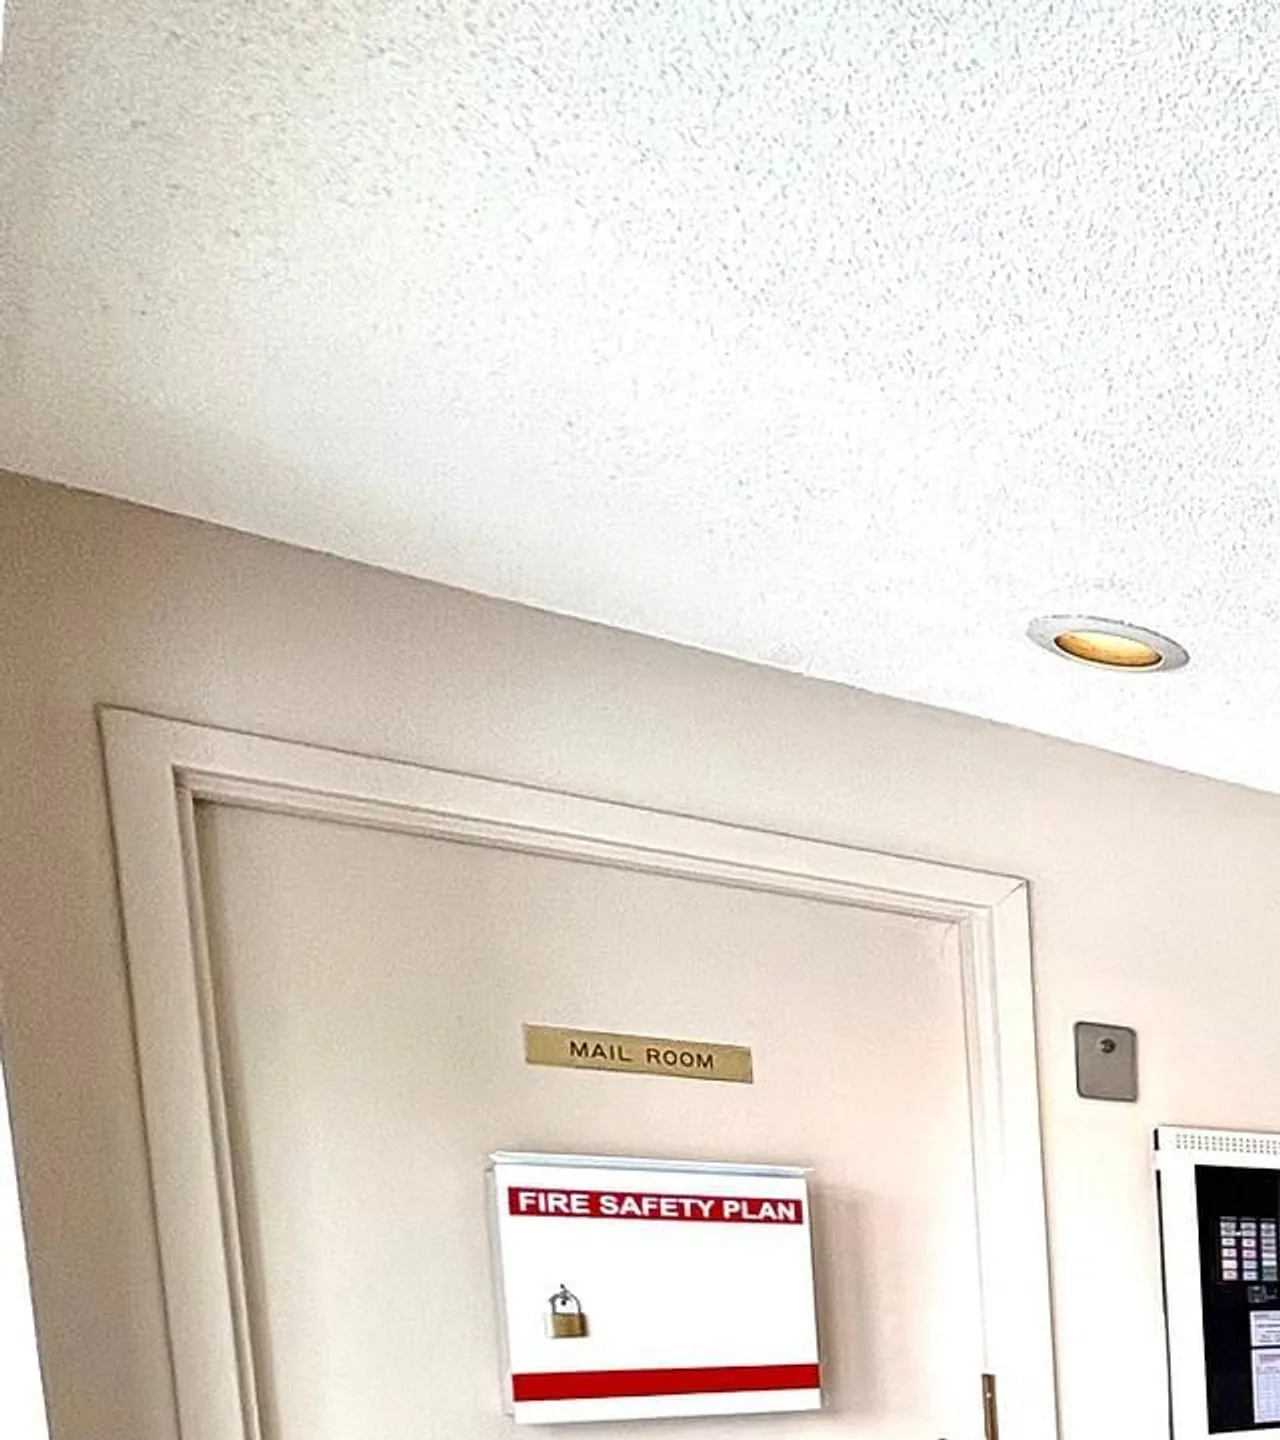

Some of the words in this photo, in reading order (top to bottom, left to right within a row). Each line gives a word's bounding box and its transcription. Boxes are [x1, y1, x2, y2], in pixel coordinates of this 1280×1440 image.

[569, 1039, 631, 1062] MAIL
[646, 1047, 715, 1070] ROOM
[518, 1191, 590, 1214] FIRE
[599, 1195, 716, 1218] SAFETY
[723, 1199, 796, 1221] PLAN
